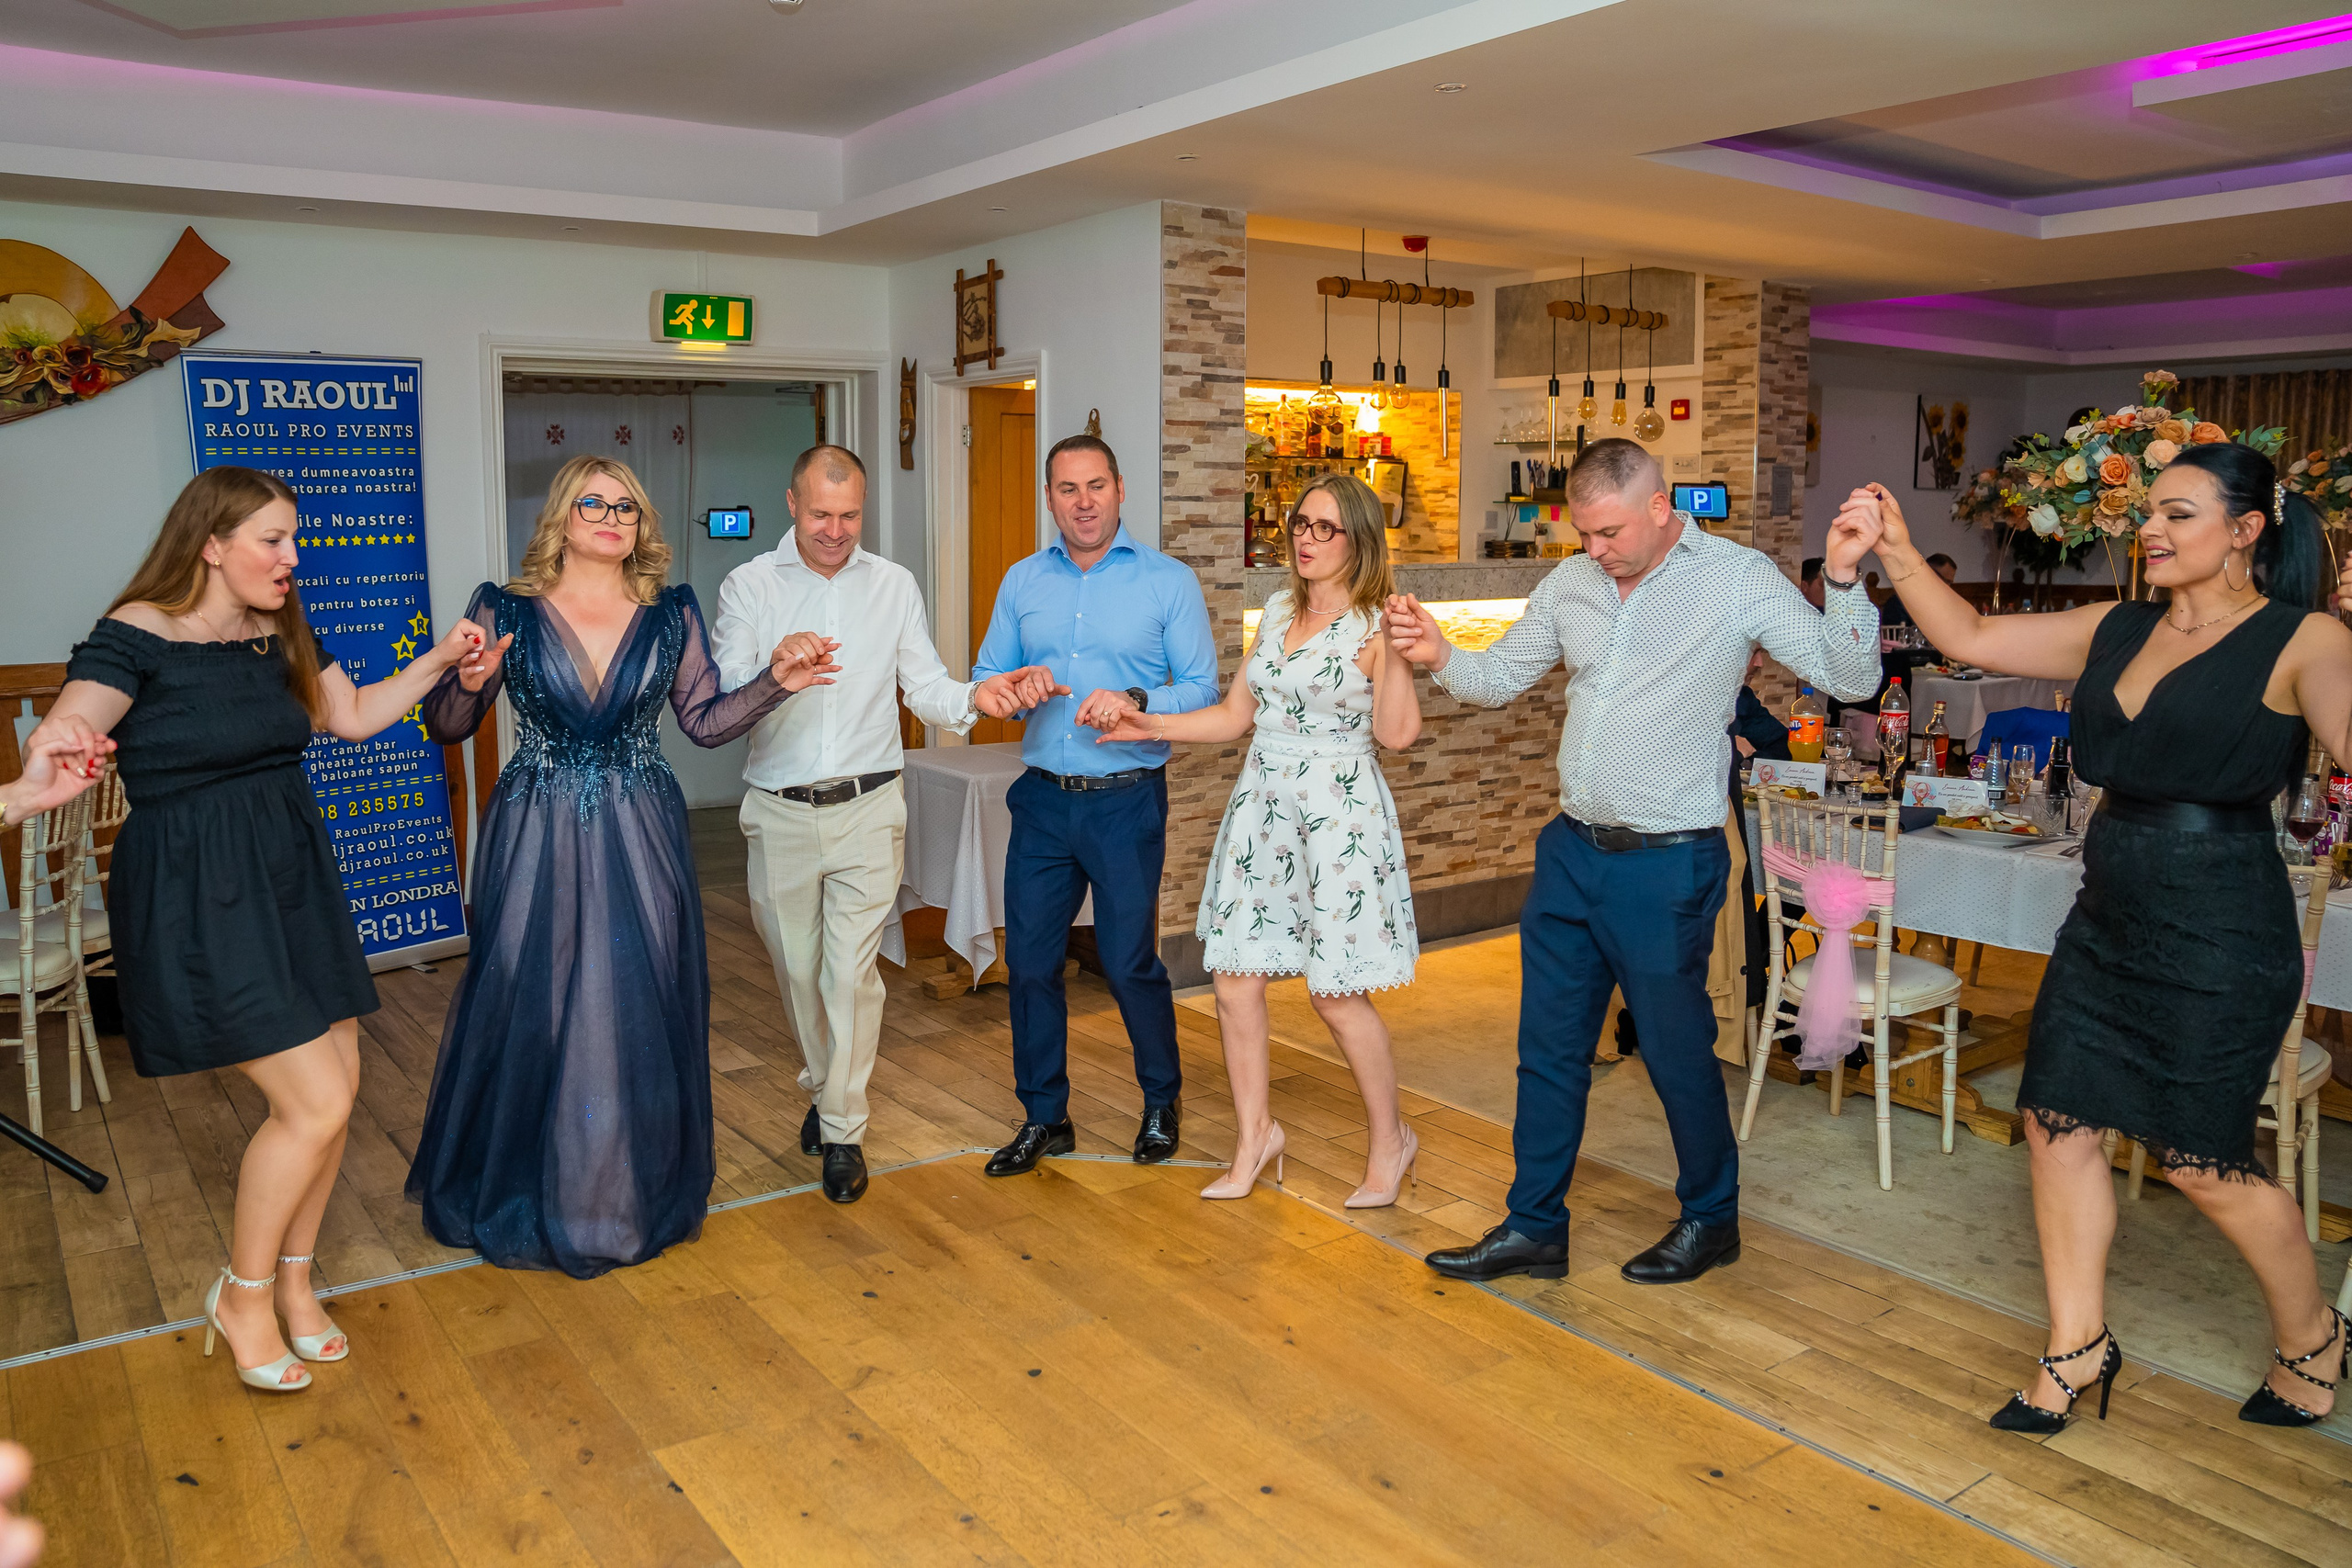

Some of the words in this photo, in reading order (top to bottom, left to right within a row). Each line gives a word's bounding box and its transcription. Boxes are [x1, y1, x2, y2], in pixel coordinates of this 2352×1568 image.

[200, 378, 251, 416] DJ
[260, 378, 398, 411] RAOUL
[204, 423, 279, 437] RAOUL
[288, 423, 327, 438] PRO
[336, 424, 414, 438] EVENTS
[301, 467, 414, 478] dumneavoastra
[291, 483, 347, 494] atoarea
[355, 481, 417, 493] noastra!
[1693, 491, 1708, 510] P
[298, 513, 322, 528] ile
[332, 513, 413, 527] Noastre:
[725, 514, 736, 530] P
[297, 575, 329, 587] ocali
[335, 577, 350, 585] cu
[356, 571, 425, 585] repertoriu
[310, 600, 354, 613] pentru
[360, 597, 399, 608] botez
[404, 594, 415, 605] si
[314, 626, 329, 635] cu
[334, 623, 385, 634] diverse
[348, 659, 366, 669] lui
[332, 743, 369, 756] candy
[375, 741, 396, 750] bar
[311, 758, 355, 773] gheata
[360, 749, 430, 764] carbonica,
[322, 768, 373, 782] baloane
[379, 762, 418, 774] sapun
[318, 805, 338, 819] 8
[349, 792, 424, 817] 235575
[334, 816, 442, 840] RaoulProEvents
[339, 845, 448, 874] djraoul.co.uk
[349, 897, 367, 913] N
[371, 881, 458, 908] LONDRA
[356, 908, 450, 945] AOUL
